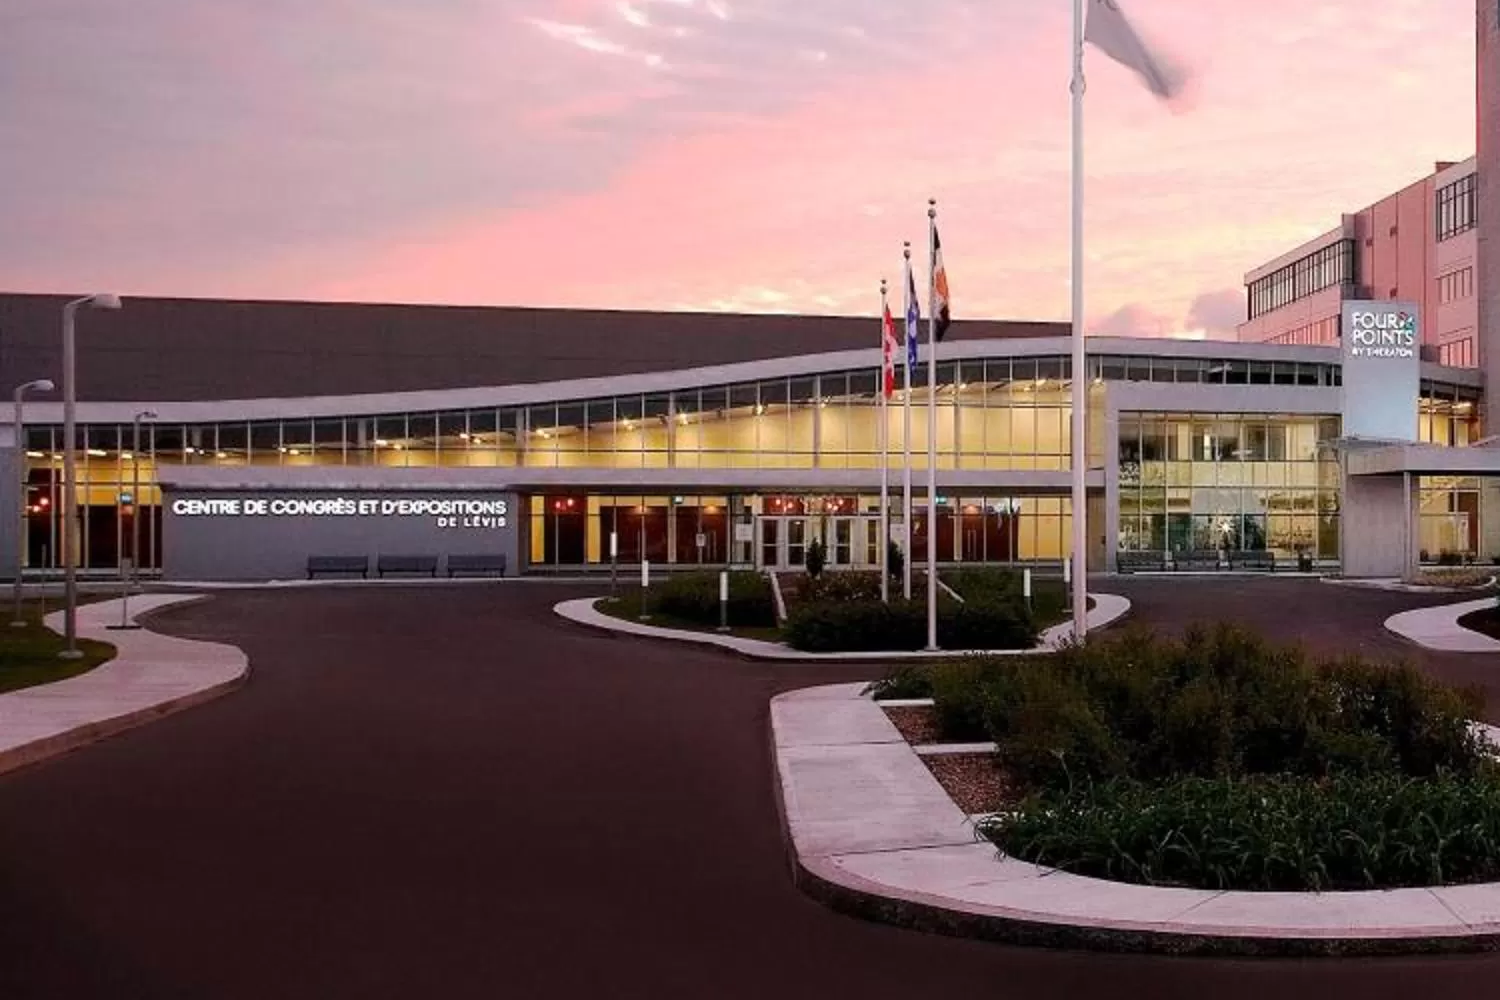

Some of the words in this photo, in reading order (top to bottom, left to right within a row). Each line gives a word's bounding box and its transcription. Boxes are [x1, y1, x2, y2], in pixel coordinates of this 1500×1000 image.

[1352, 312, 1398, 329] FOUR
[1353, 329, 1413, 345] POINTS
[173, 499, 240, 515] CENTRE
[243, 499, 268, 515] DE
[271, 497, 357, 515] CONGRÈS
[358, 500, 379, 515] ET
[381, 500, 507, 515] D'EXPOSITIONS
[437, 517, 457, 527] DE
